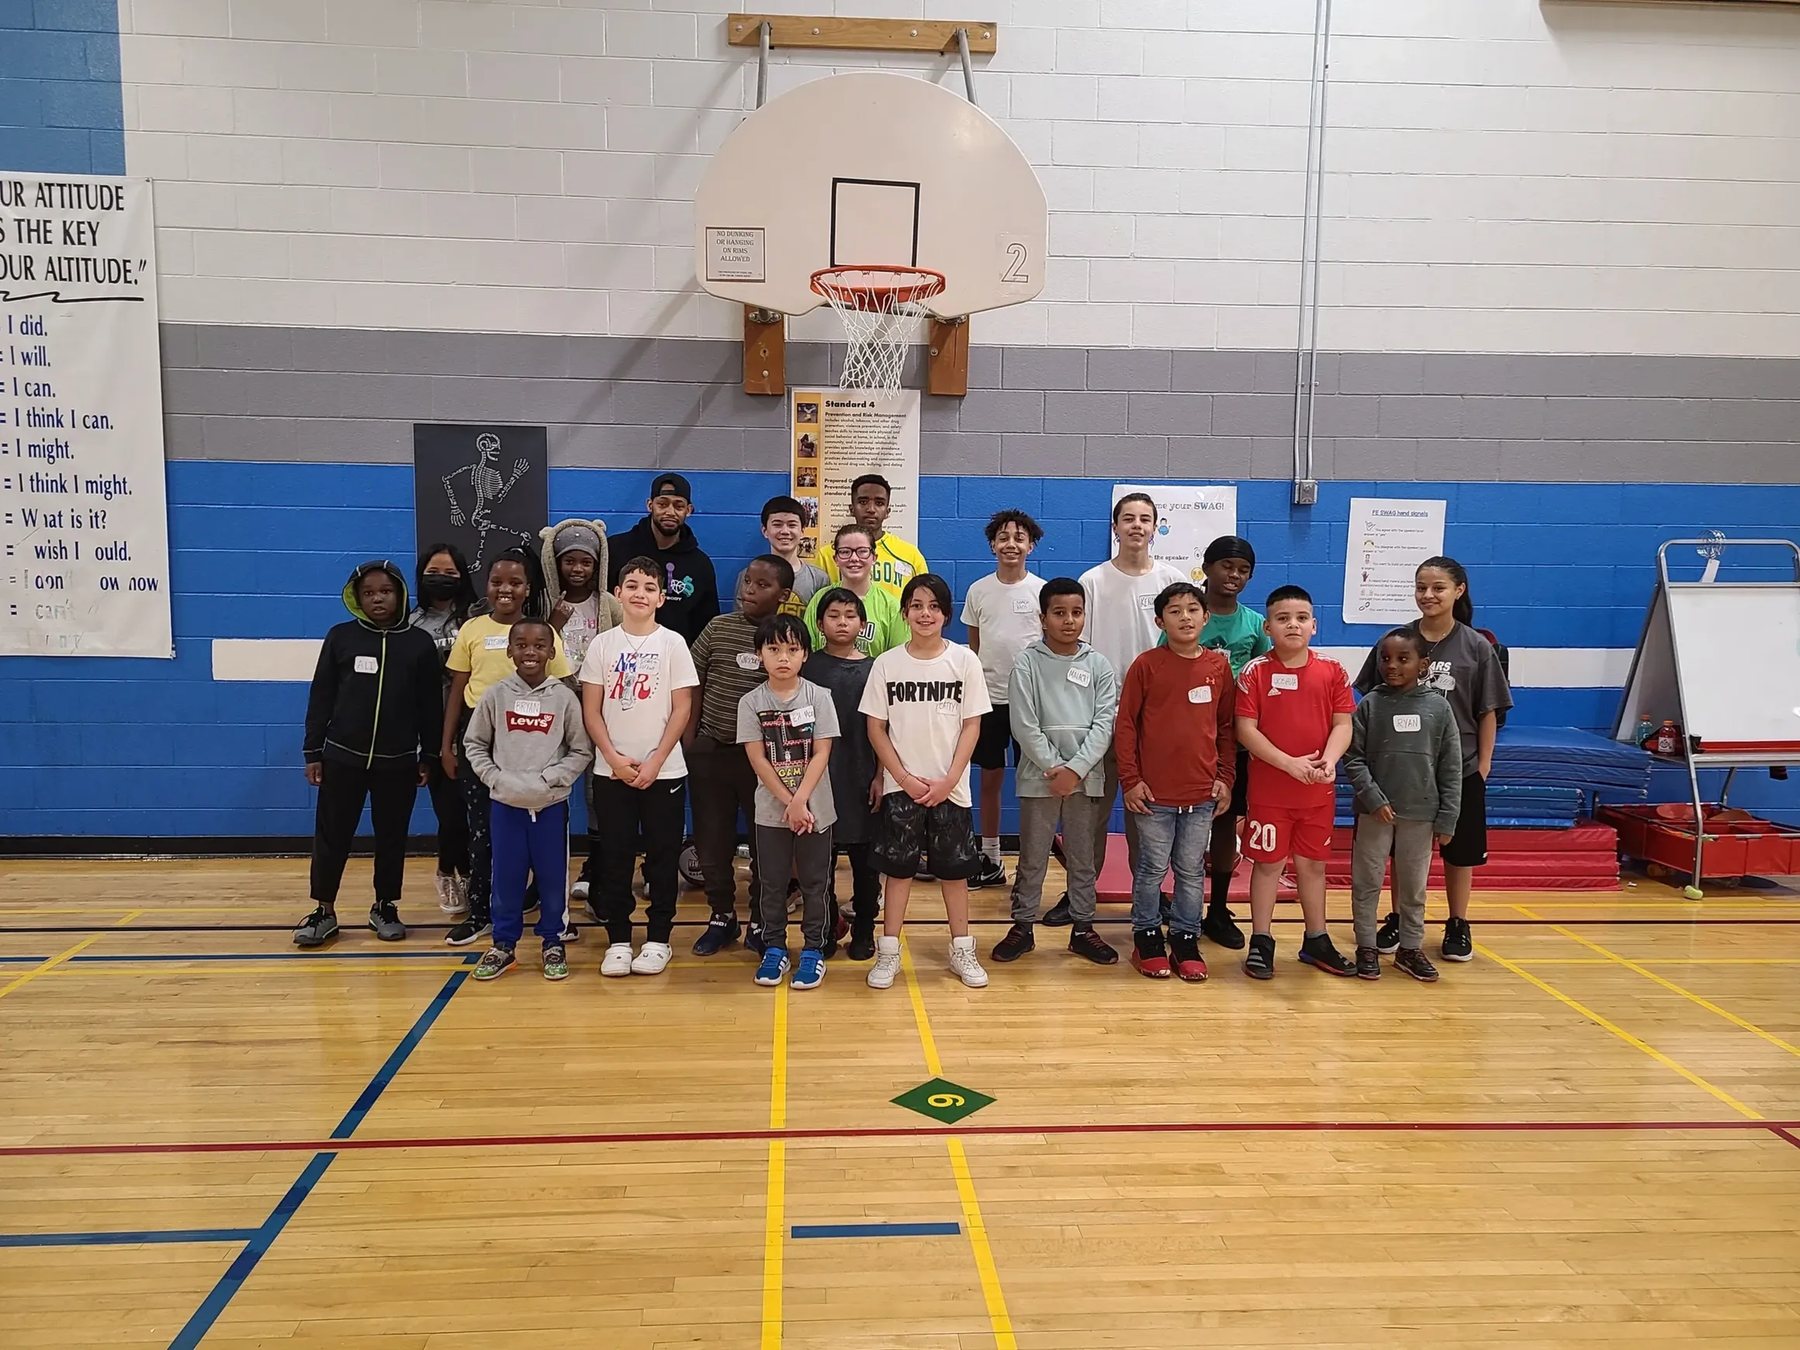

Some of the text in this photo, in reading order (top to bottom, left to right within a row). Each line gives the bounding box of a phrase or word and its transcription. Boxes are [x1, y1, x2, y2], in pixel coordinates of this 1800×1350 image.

[35, 182, 124, 211] ATTITUDE
[14, 218, 52, 244] THE
[63, 220, 100, 246] KEY
[1001, 242, 1029, 283] 2
[8, 314, 48, 336] I did.
[10, 345, 15, 366] I
[21, 345, 51, 367] will.
[13, 376, 18, 397] I
[24, 382, 56, 398] can.
[825, 400, 867, 408] Standard
[15, 407, 20, 427] I
[26, 406, 64, 429] think
[71, 408, 76, 429] I
[82, 414, 114, 430] can.
[16, 438, 21, 457] I
[28, 438, 75, 464] might.
[19, 473, 24, 492] I
[30, 472, 68, 493] think
[74, 475, 79, 494] I
[85, 474, 132, 501] might.
[1169, 503, 1191, 512] your
[1193, 501, 1225, 511] SWAG!
[71, 508, 82, 529] is
[89, 509, 107, 529] it?
[34, 539, 68, 560] wish
[75, 541, 80, 560] I
[95, 541, 131, 561] ould.
[1427, 660, 1452, 672] ARS
[886, 681, 963, 706] FORTNITE
[1249, 820, 1277, 852] 20
